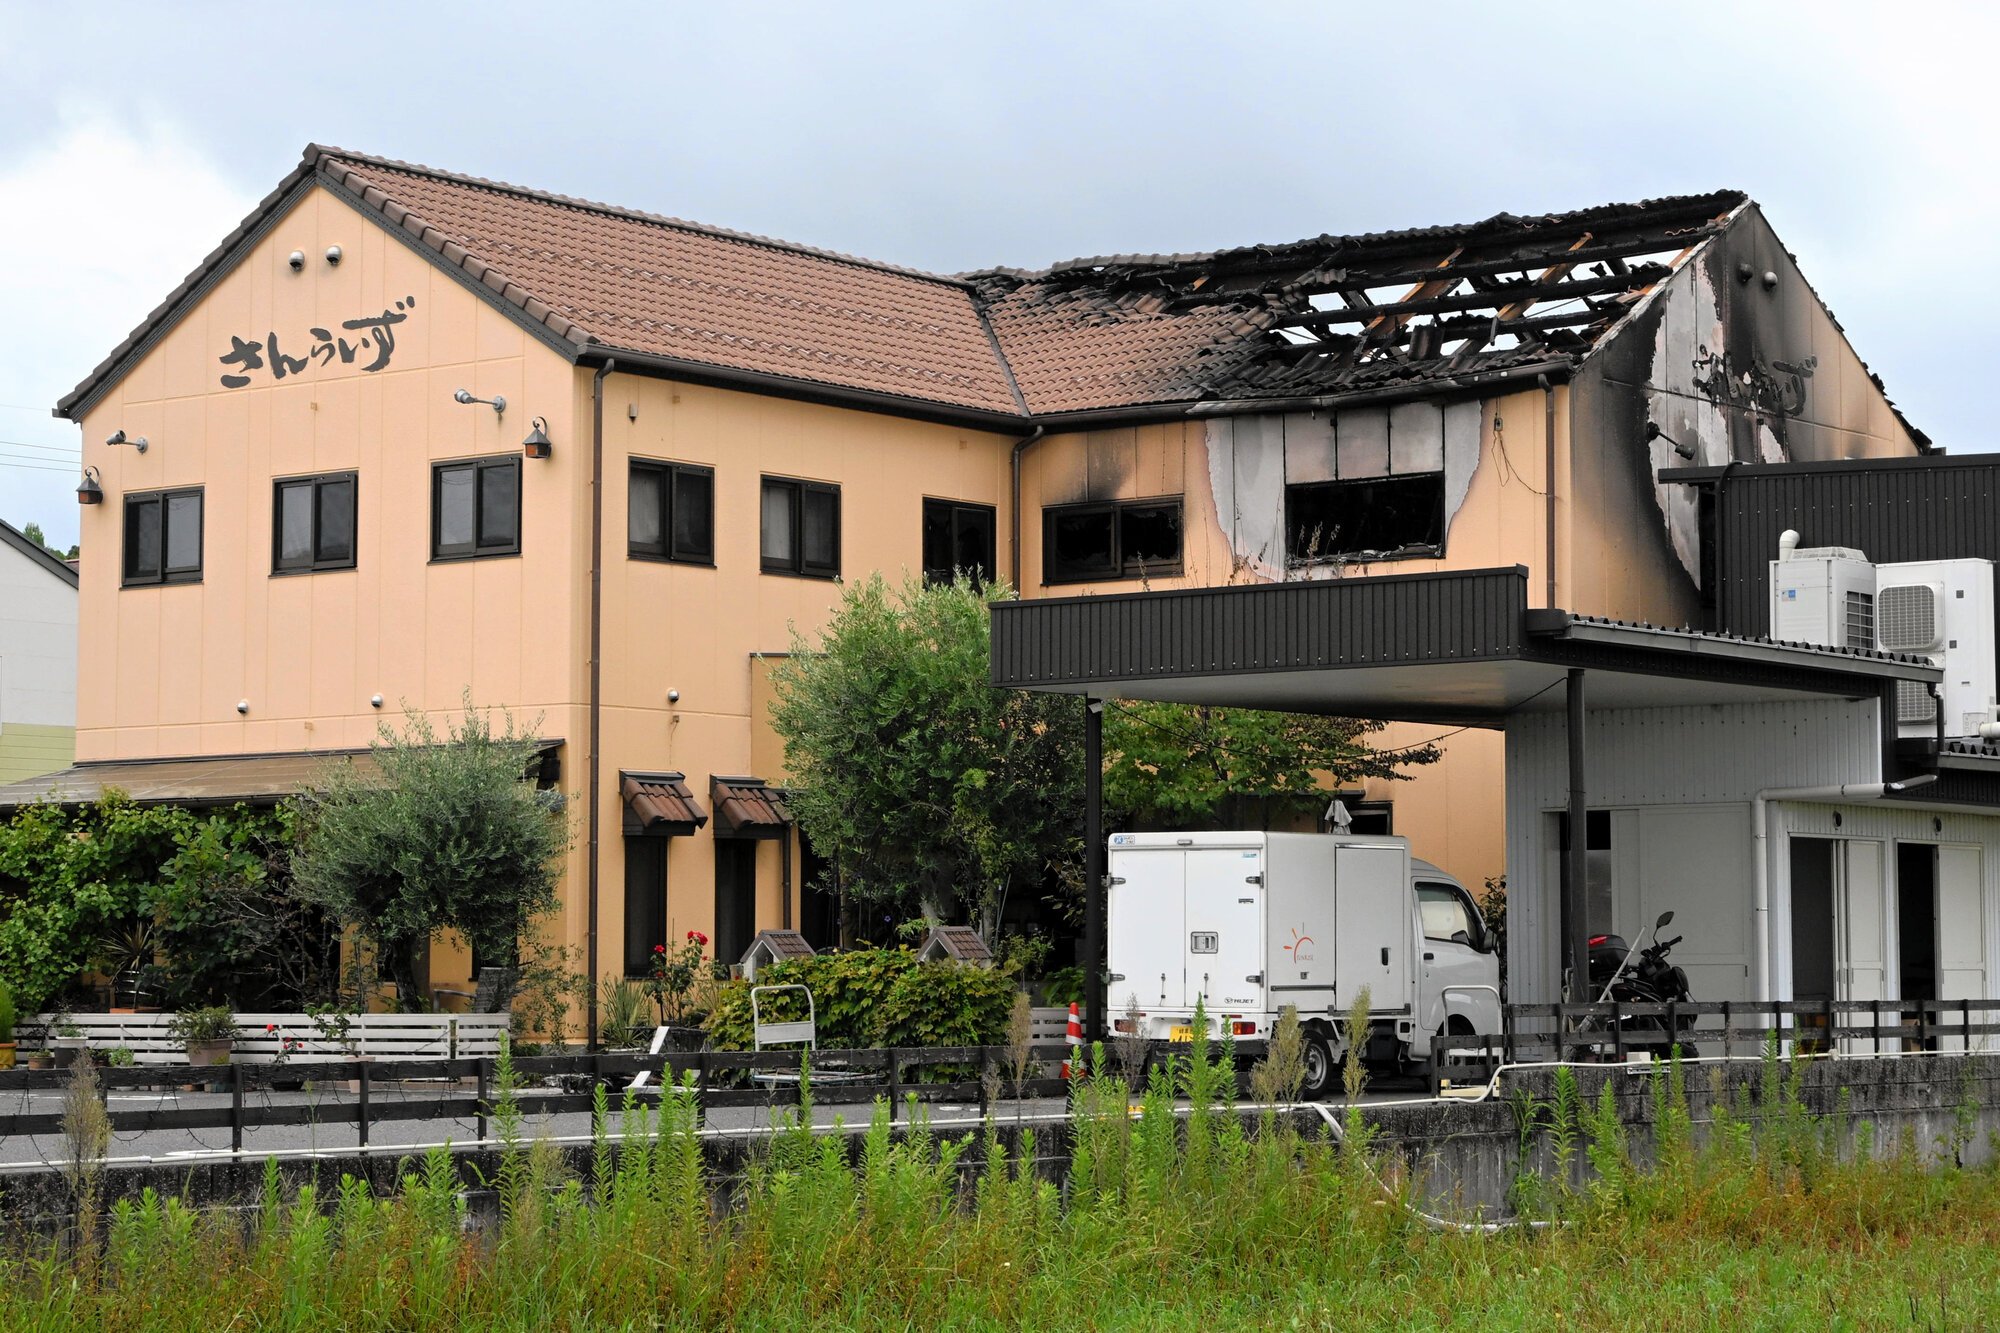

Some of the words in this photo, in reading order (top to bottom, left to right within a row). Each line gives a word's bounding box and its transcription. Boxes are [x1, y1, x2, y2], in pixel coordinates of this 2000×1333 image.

[219, 296, 415, 388] さんらいず
